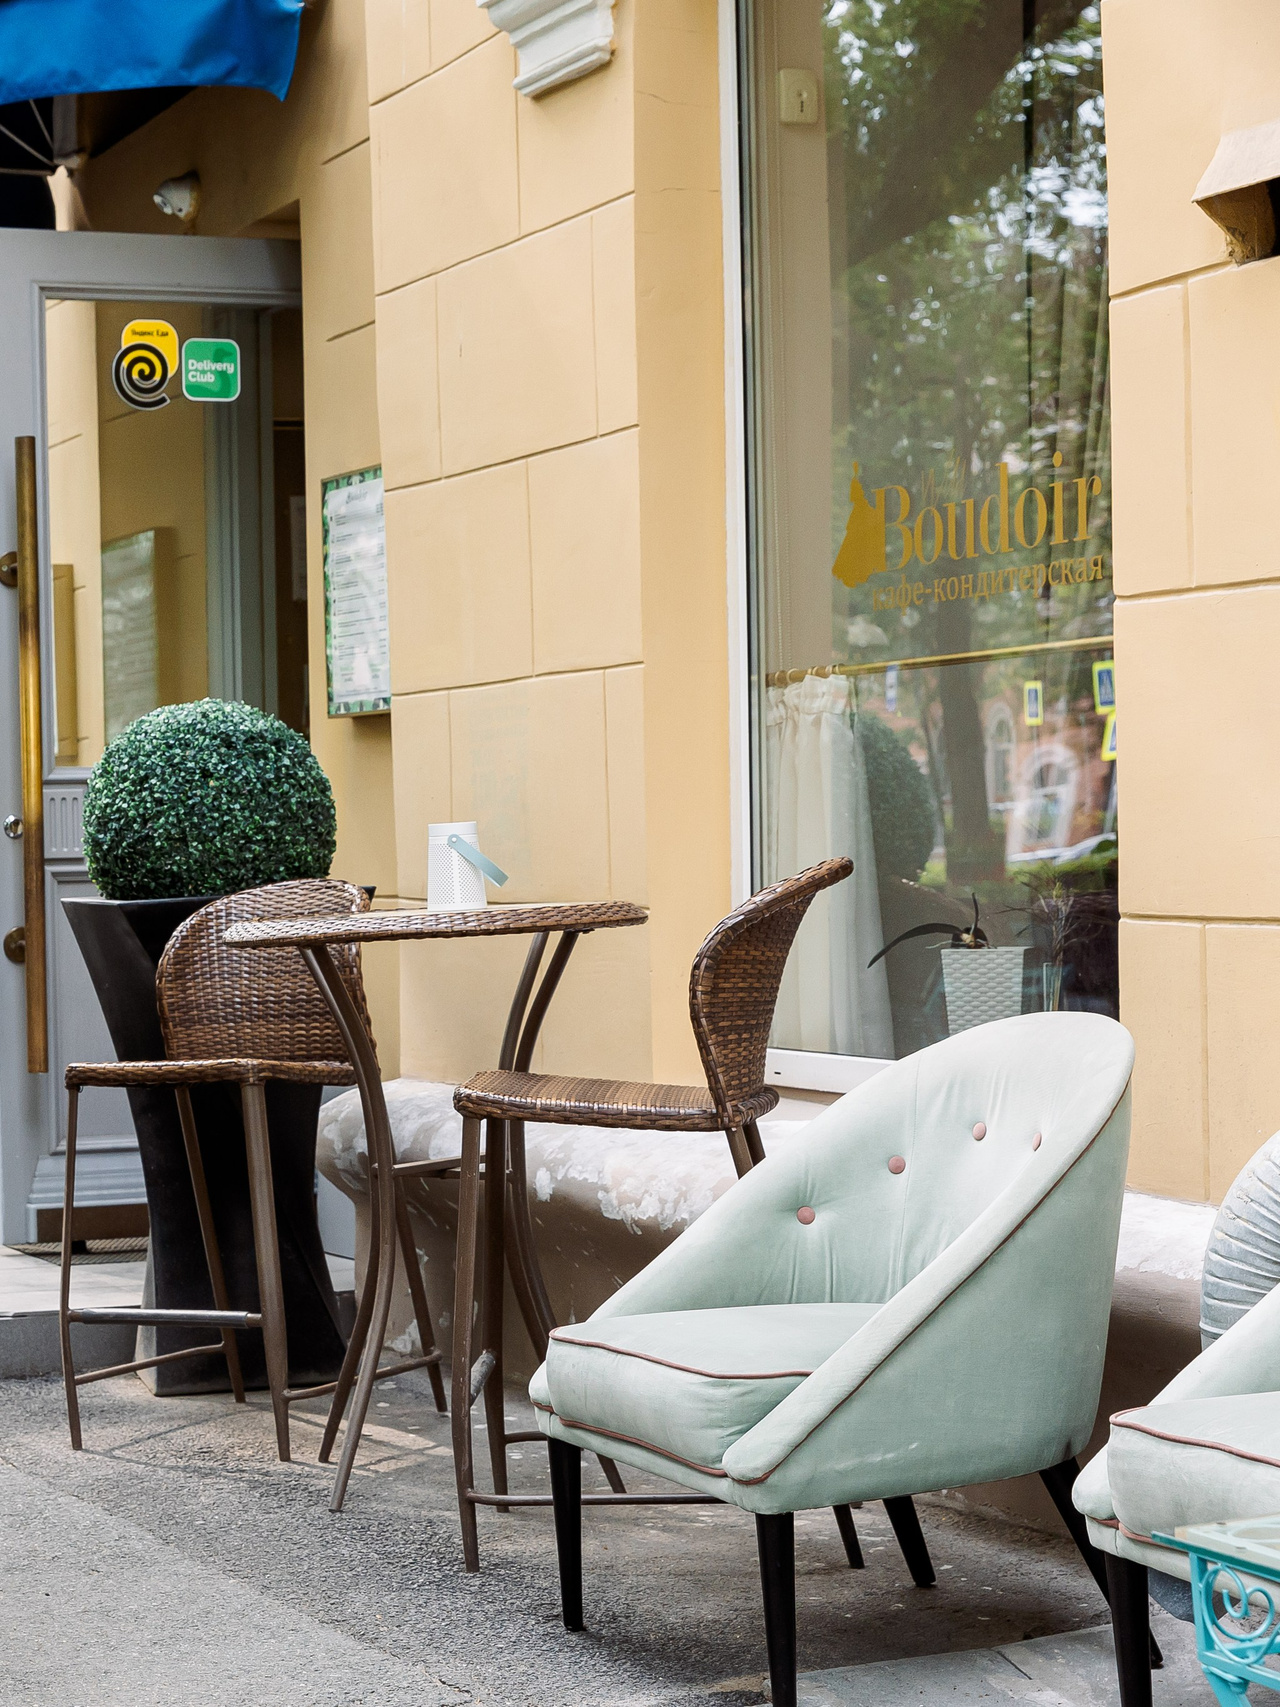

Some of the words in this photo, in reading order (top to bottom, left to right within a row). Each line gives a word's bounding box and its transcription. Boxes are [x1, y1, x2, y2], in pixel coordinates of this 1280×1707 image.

[188, 359, 235, 373] Delivery
[188, 372, 215, 383] Club
[871, 450, 1103, 573] Boudoir
[872, 553, 1104, 616] кафе-кондитерская
